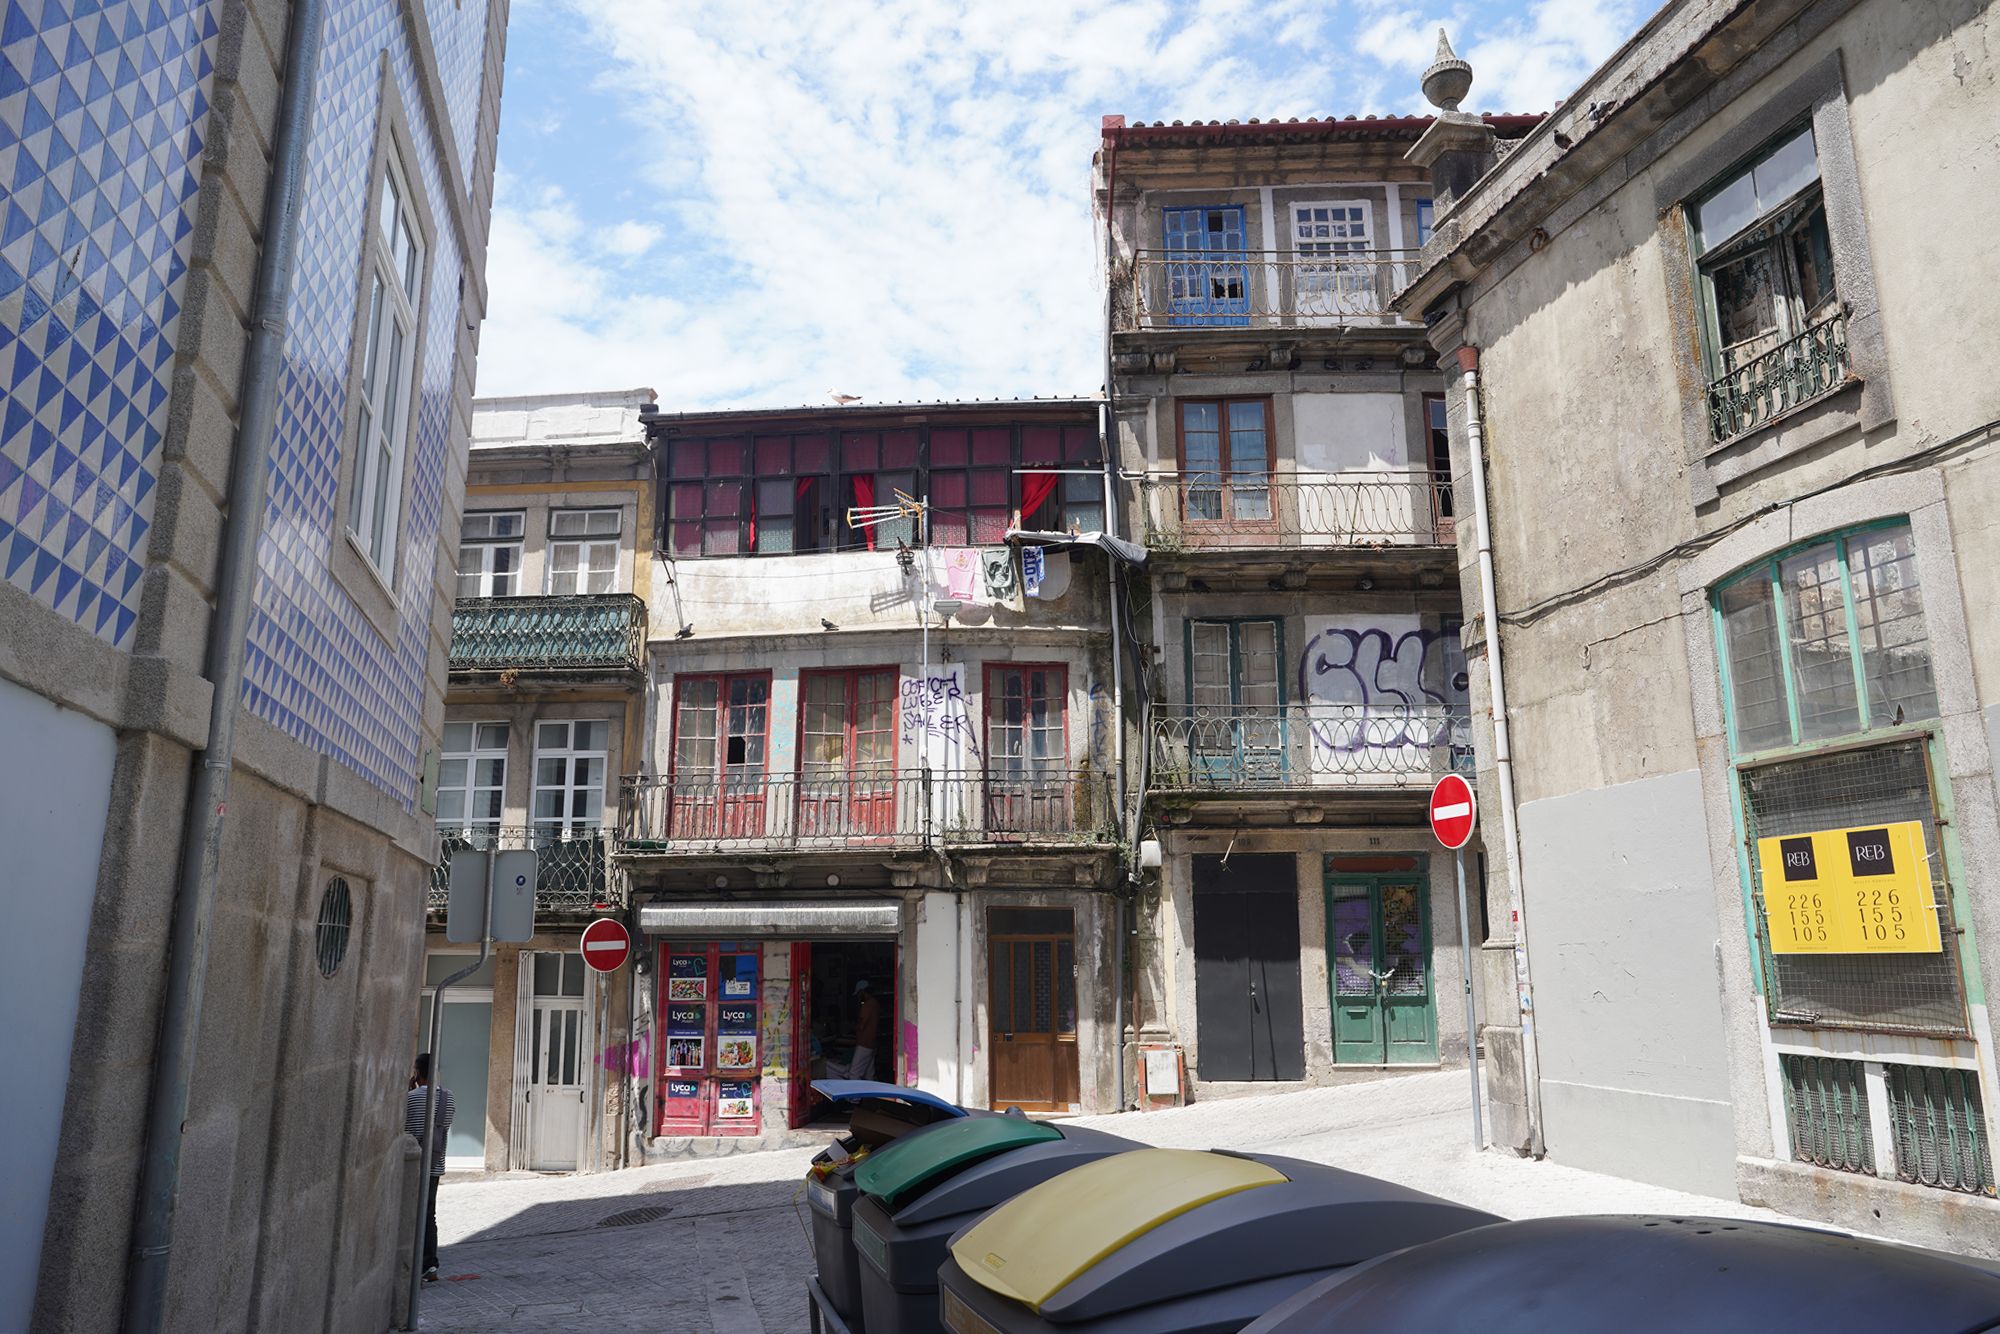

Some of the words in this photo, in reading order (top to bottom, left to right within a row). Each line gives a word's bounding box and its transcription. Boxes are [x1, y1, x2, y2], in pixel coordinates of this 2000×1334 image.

[1786, 851, 1810, 867] REB
[1855, 844, 1886, 862] REB
[1788, 893, 1822, 909] 226
[1857, 888, 1900, 906] 226
[1790, 909, 1825, 925] 155
[1859, 906, 1903, 923] 155
[1792, 926, 1827, 941] 105
[1862, 923, 1906, 940] 105
[672, 1011, 694, 1020] Lyca
[723, 1010, 745, 1020] Lyca
[671, 1083, 690, 1092] Lyca
